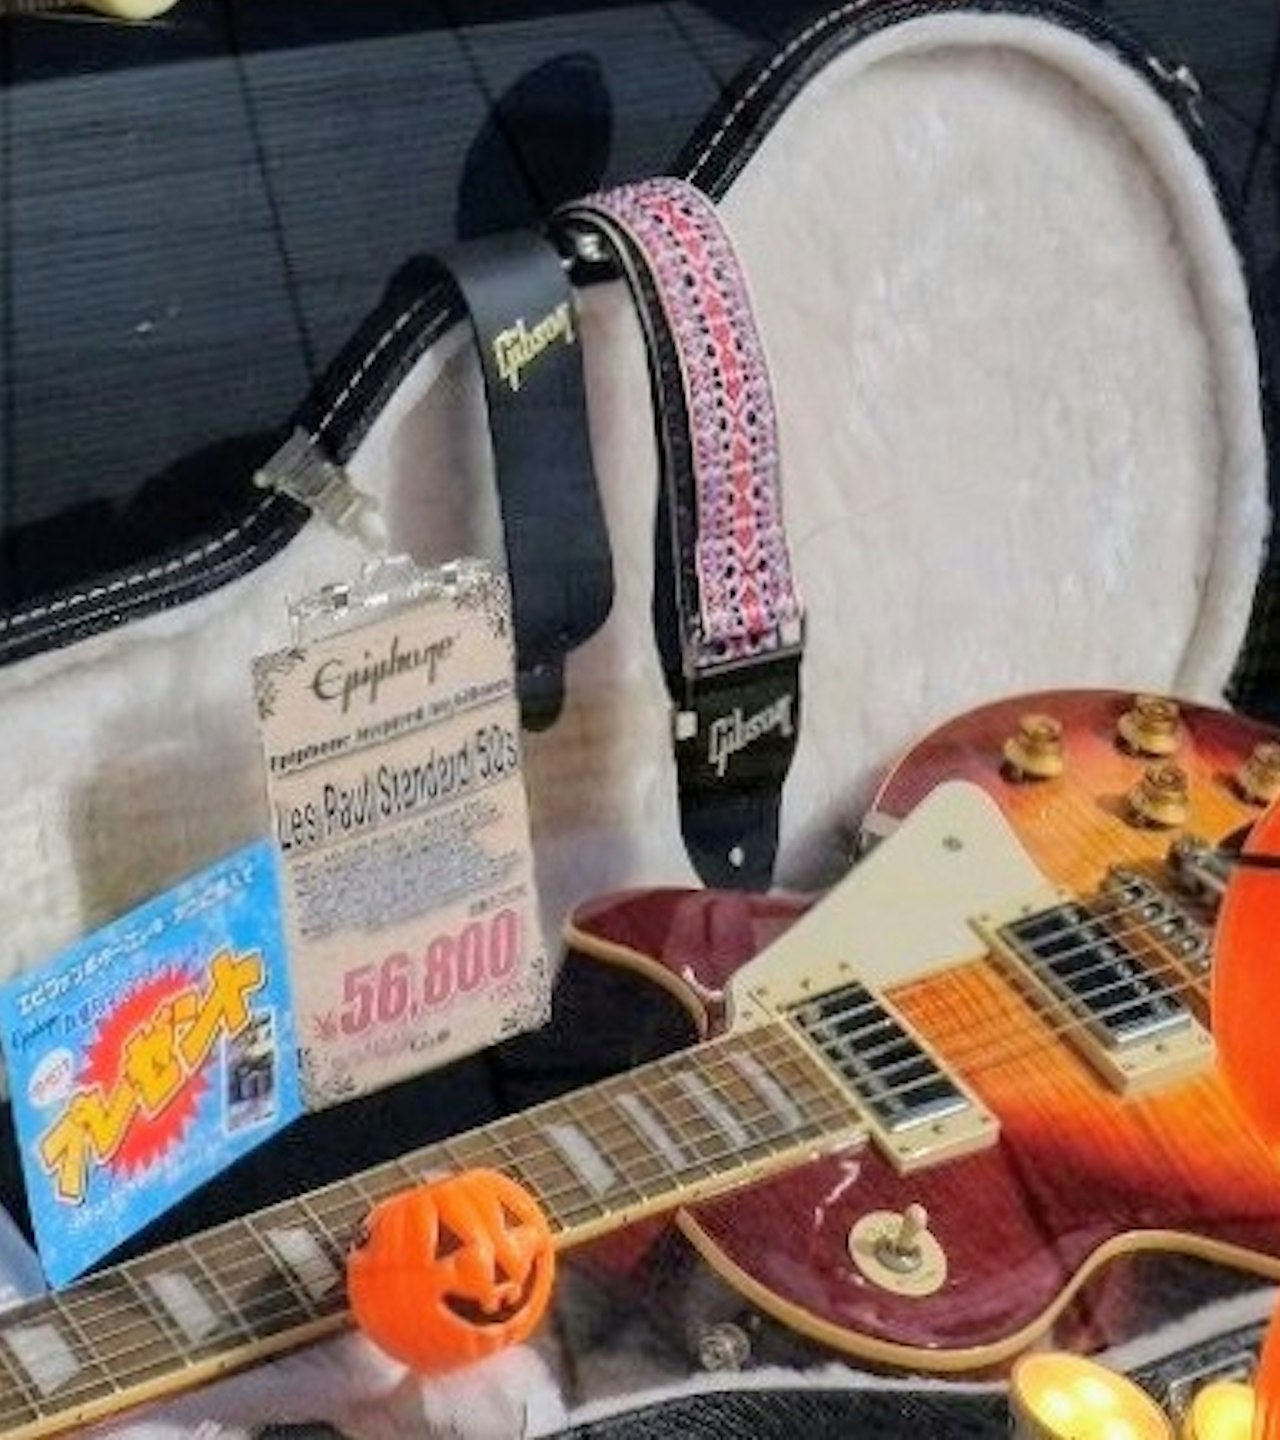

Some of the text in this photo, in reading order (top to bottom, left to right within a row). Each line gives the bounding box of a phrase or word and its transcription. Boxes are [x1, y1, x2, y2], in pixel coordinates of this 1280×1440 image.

[494, 304, 576, 391] Gibson
[308, 634, 453, 714] Epiphone
[708, 697, 793, 778] Gibson
[276, 726, 519, 850] Les Paul Standard 50s
